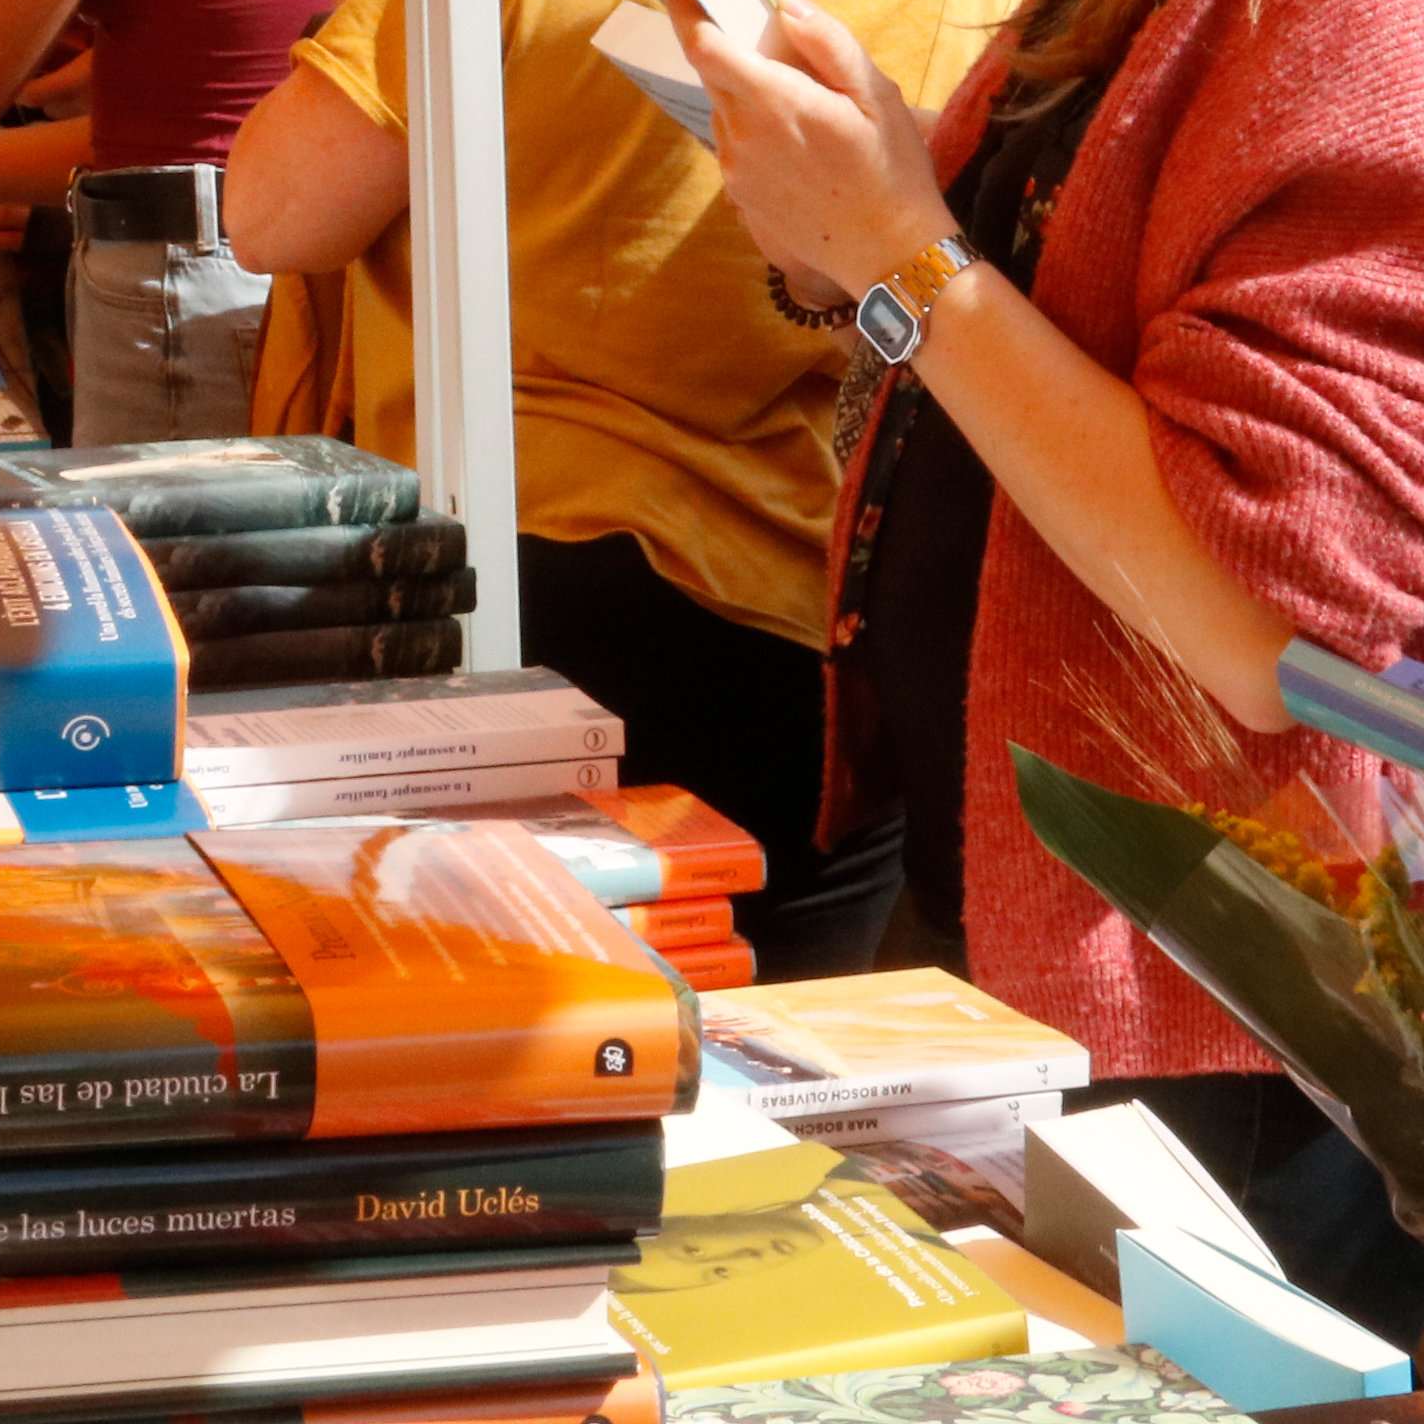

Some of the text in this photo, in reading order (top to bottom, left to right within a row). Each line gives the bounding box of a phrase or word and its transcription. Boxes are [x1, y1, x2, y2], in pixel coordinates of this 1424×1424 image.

[339, 749, 394, 764] familiar
[334, 788, 388, 804] familiar
[19, 1078, 66, 1110] las
[76, 1076, 113, 1104] de
[124, 1074, 228, 1106] ciudad
[239, 1070, 280, 1099] La
[761, 1082, 912, 1108] MAR BOSCH OLIVERAS
[795, 1118, 878, 1135] MAR BOSCH
[20, 1211, 66, 1242] las
[76, 1207, 156, 1238] luces
[167, 1204, 297, 1234] muertas
[356, 1189, 447, 1224] David
[457, 1185, 540, 1217] Uclés
